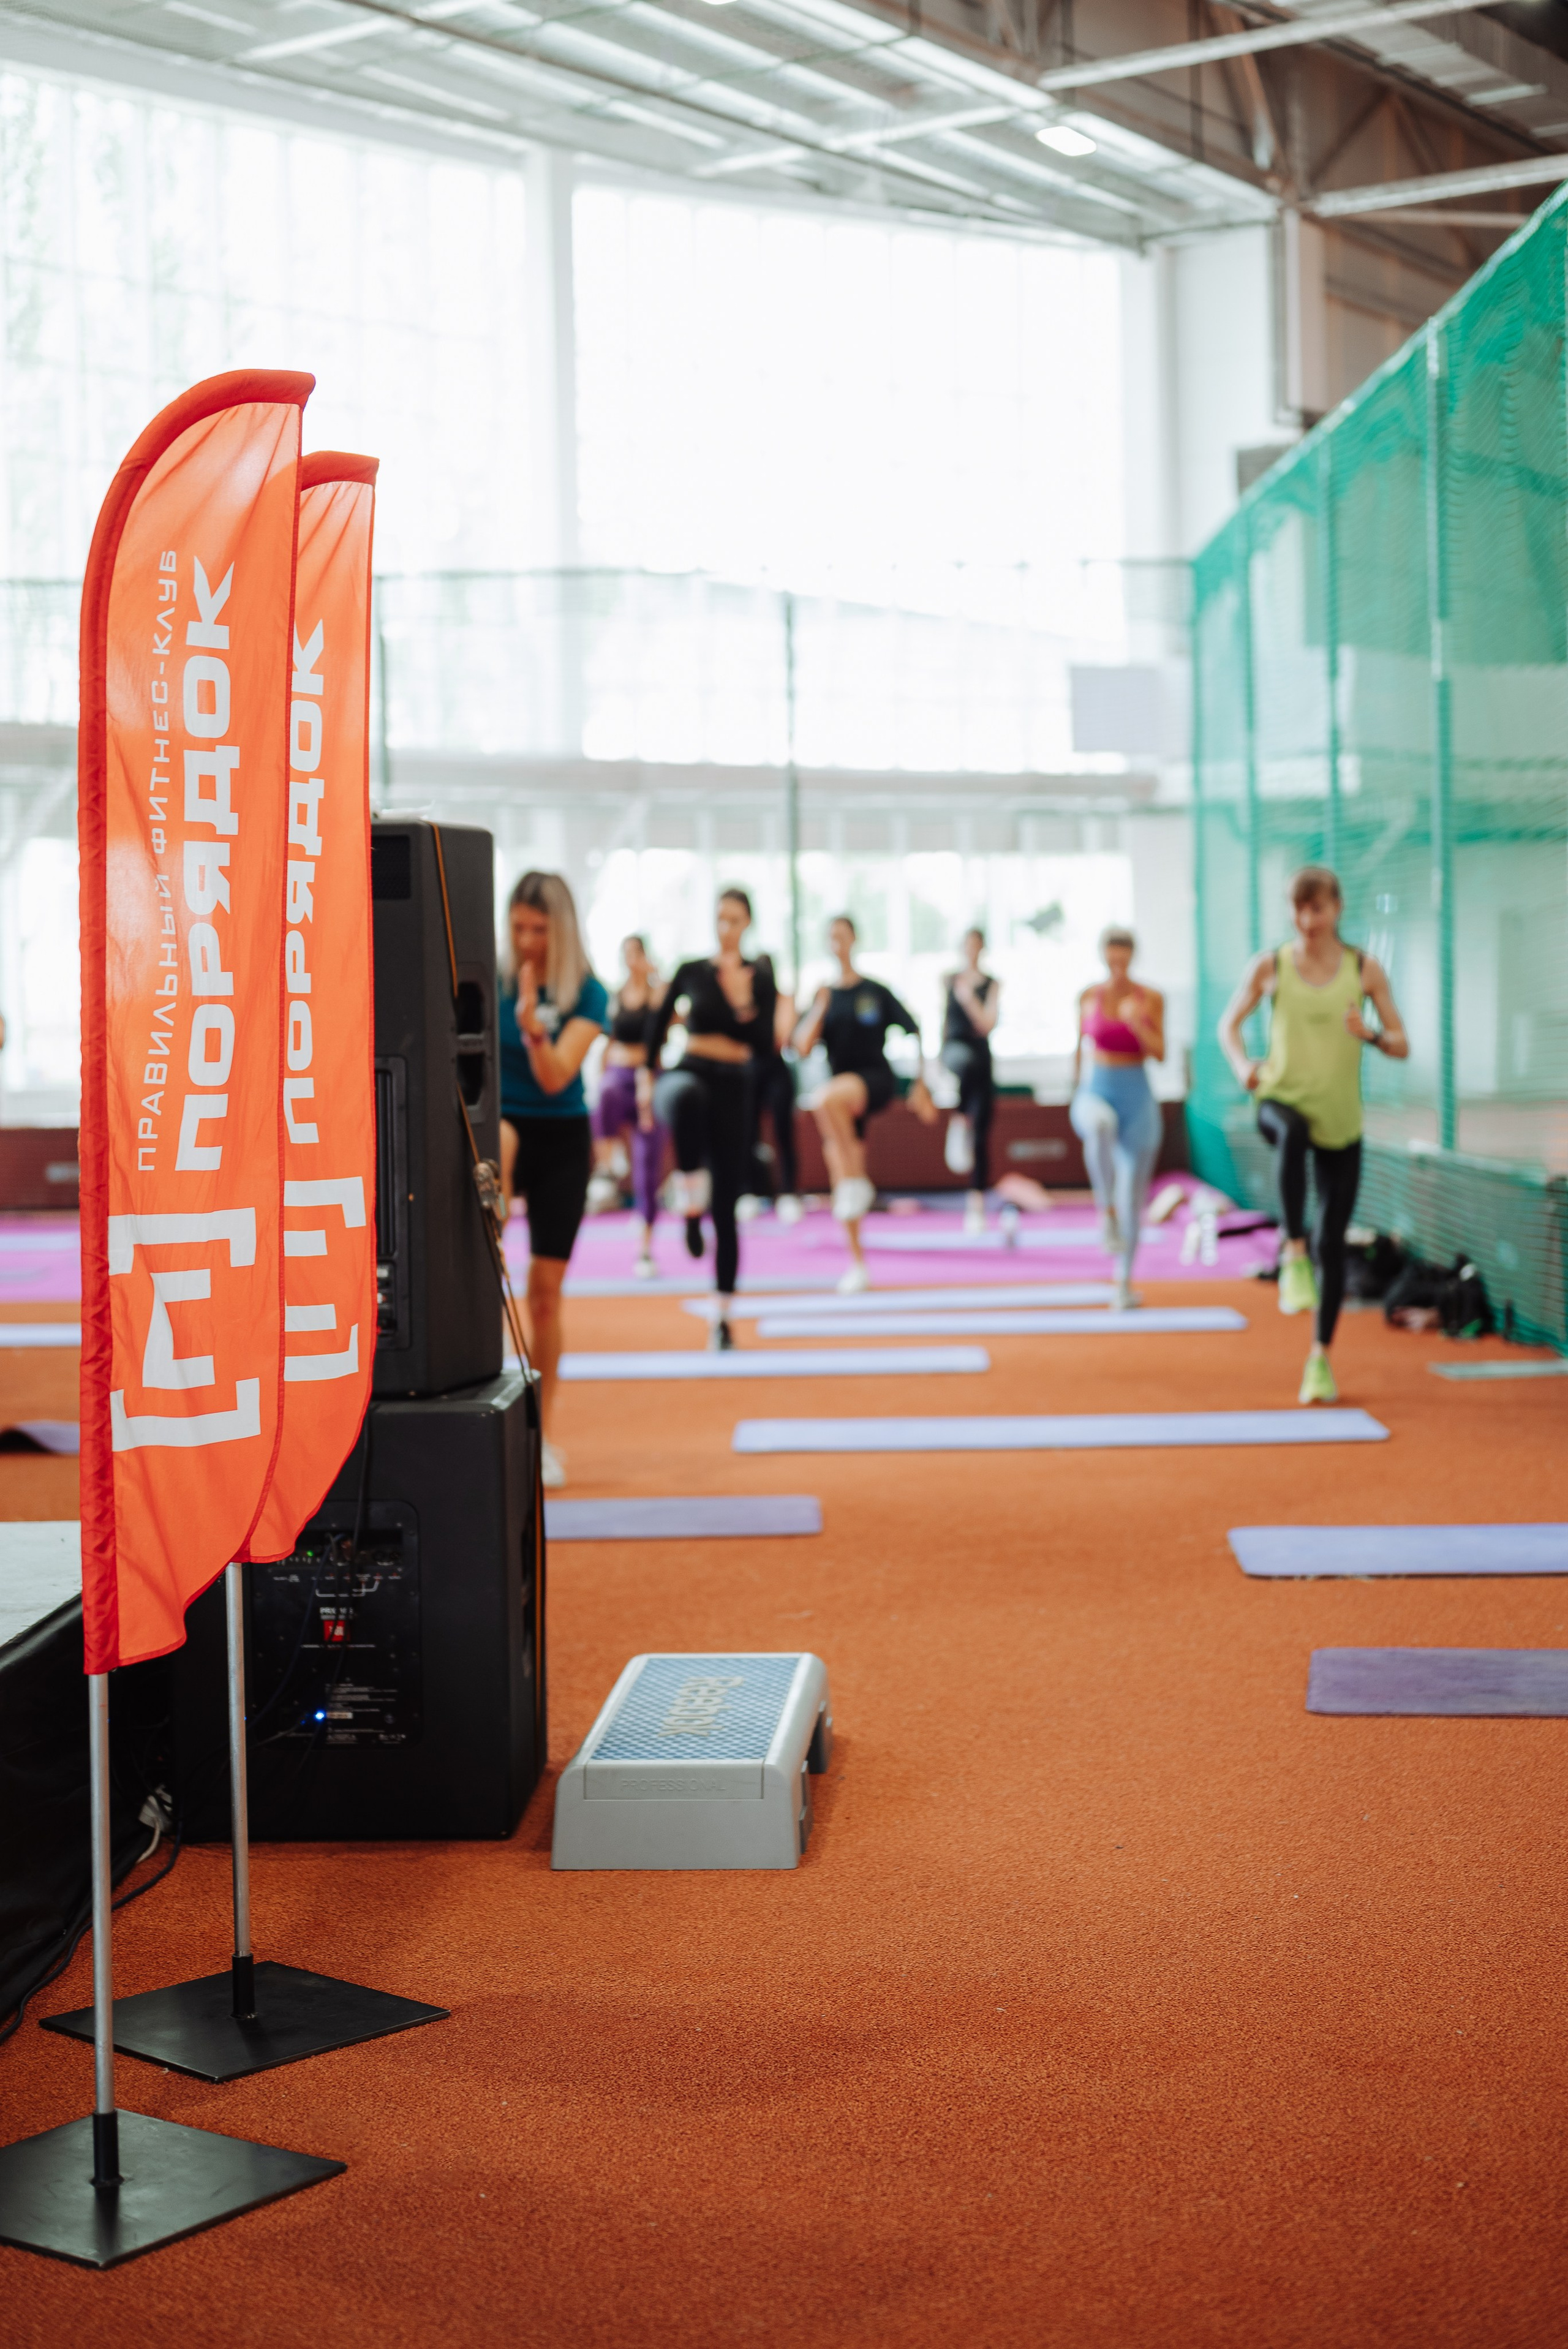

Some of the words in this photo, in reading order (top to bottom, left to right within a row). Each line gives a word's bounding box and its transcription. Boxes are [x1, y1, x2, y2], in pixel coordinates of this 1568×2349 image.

[149, 550, 177, 854] ФИТНЕС-КЛУБ
[175, 556, 240, 1171] ПОРЯДОК
[284, 619, 325, 1144] ПОРЯДОК
[137, 874, 178, 1171] ПРАВИЛЬНЫЙ
[620, 1778, 726, 1792] PROFESSIONAL
[658, 1677, 743, 1736] Reebok
